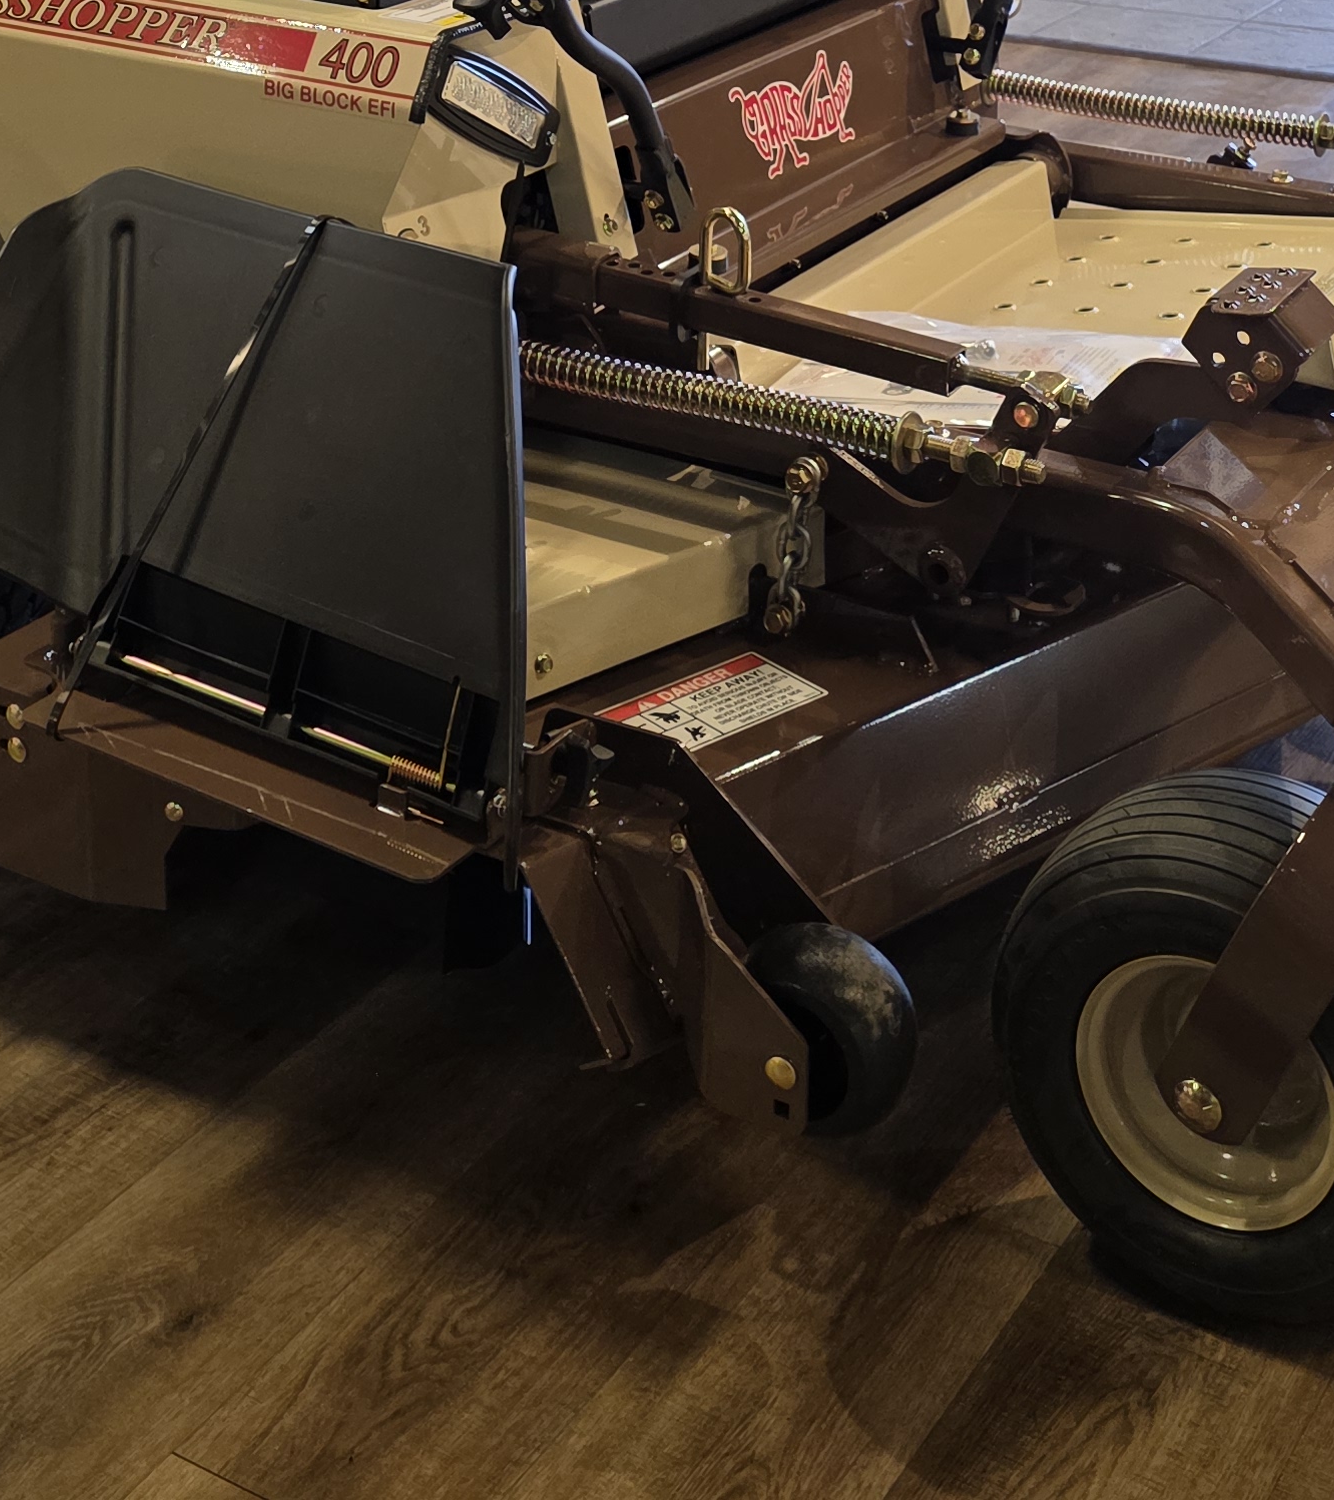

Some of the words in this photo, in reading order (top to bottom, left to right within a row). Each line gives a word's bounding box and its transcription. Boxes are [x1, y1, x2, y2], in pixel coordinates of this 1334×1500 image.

[318, 38, 400, 88] 400
[263, 78, 295, 101] BIG
[299, 86, 362, 113] BLOCK
[368, 98, 396, 119] EFI
[657, 667, 733, 703] DANGER
[689, 685, 722, 702] KEEP
[725, 669, 765, 689] AWAY!
[713, 697, 732, 707] FROM
